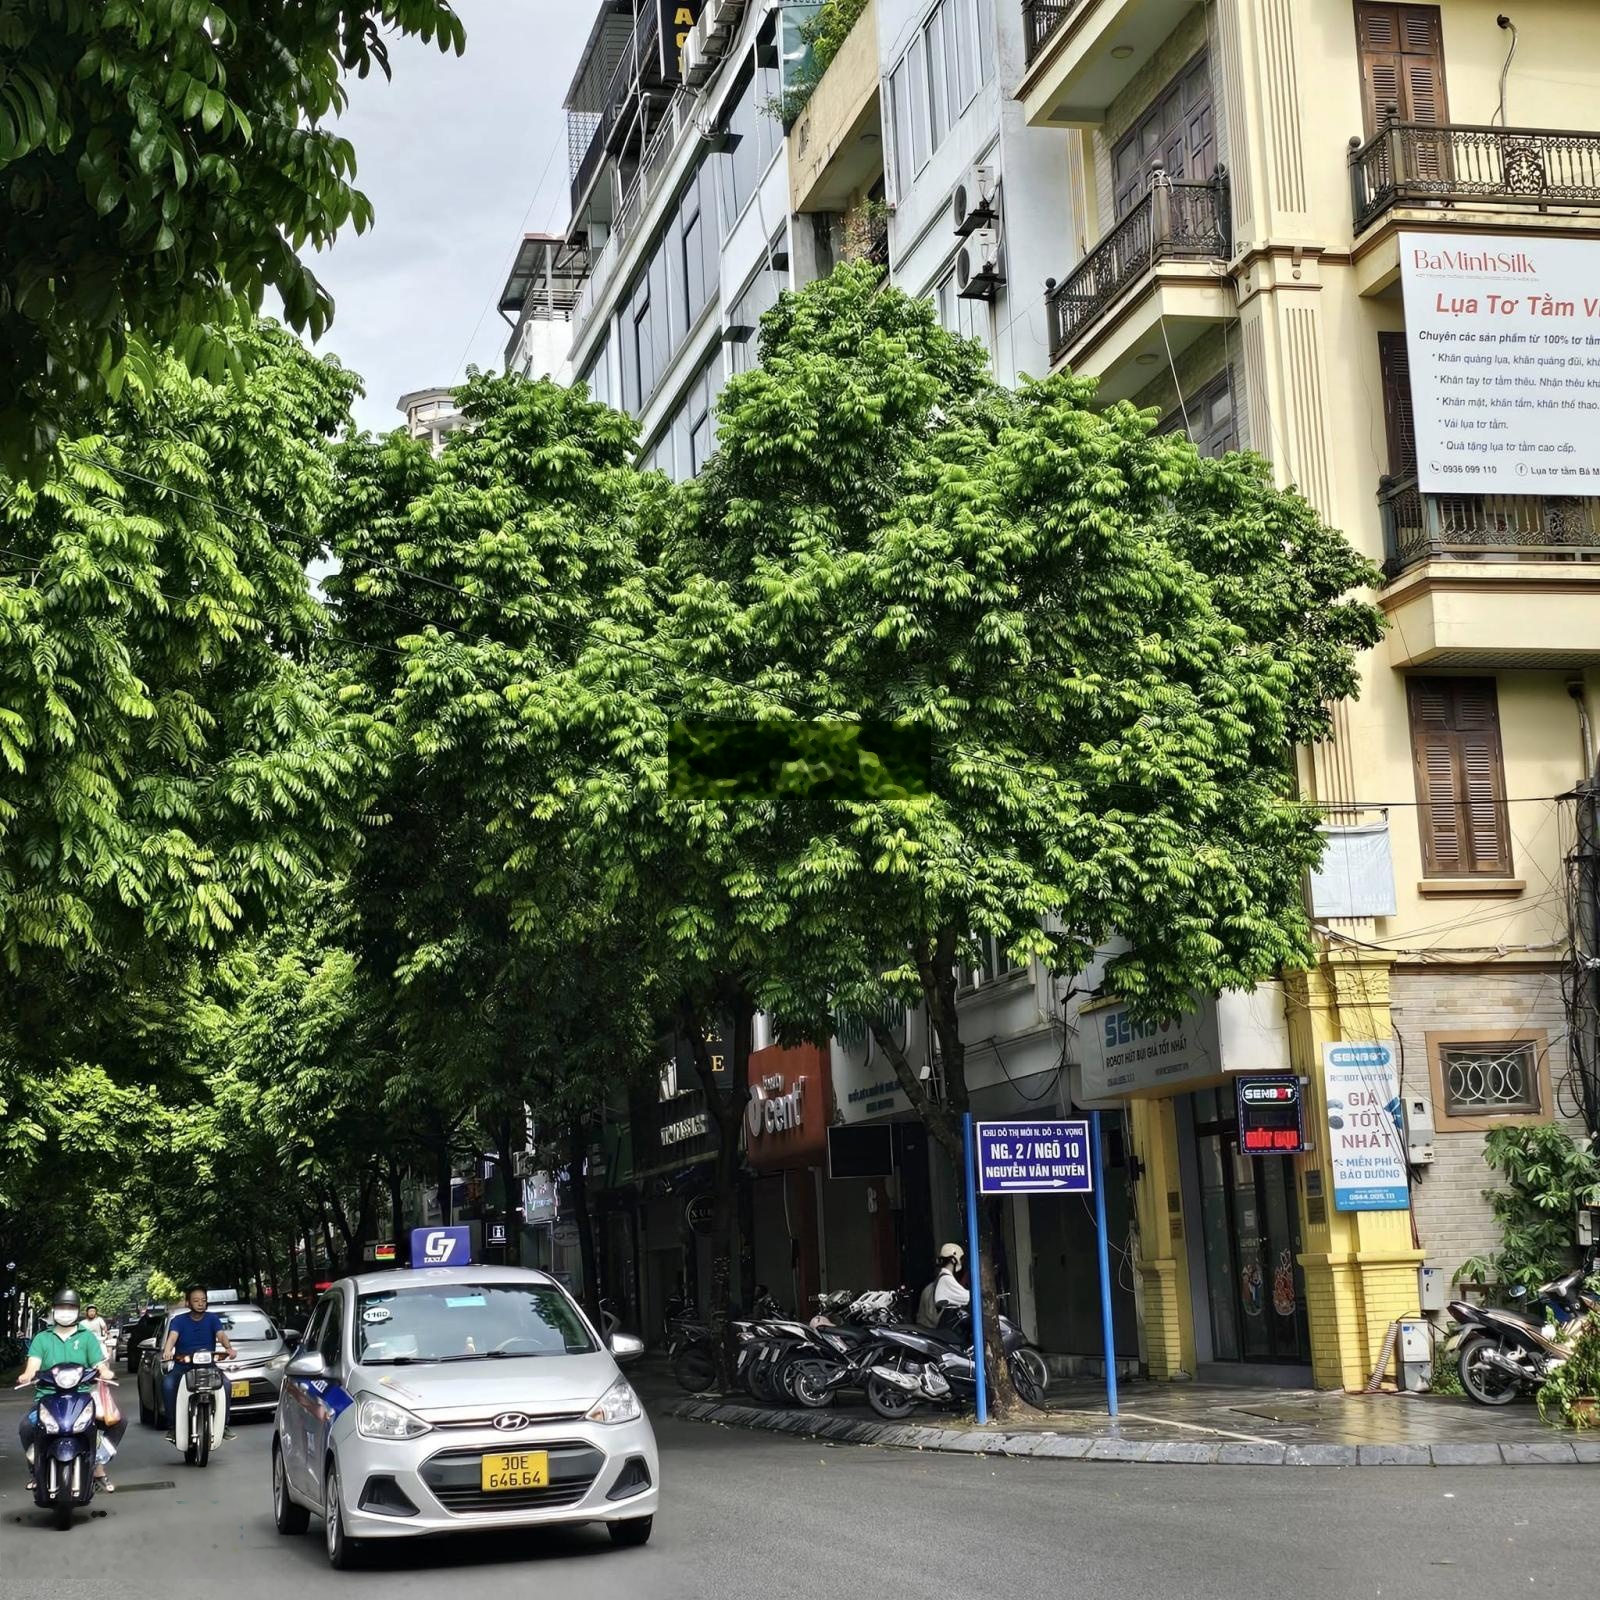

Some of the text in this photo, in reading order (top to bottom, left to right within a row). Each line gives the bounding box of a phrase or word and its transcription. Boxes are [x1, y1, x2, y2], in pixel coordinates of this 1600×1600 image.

[1414, 249, 1536, 273] BaMinhSilk
[1436, 293, 1478, 317] Lụa
[1487, 295, 1519, 315] Tơ
[1527, 293, 1574, 316] Tằm
[1419, 331, 1456, 343] Chuyên
[1459, 332, 1476, 342] các
[1479, 332, 1496, 342] sản
[1499, 332, 1526, 344] phẩm
[1529, 333, 1541, 343] từ
[1544, 335, 1568, 344] 100%
[1571, 336, 1582, 345] tơ
[1438, 353, 1461, 363] Khăn
[1440, 375, 1463, 385] Khăn
[1466, 376, 1480, 387] tay
[1483, 377, 1493, 385] tơ
[1442, 397, 1465, 407] Khăn
[1491, 398, 1513, 408] khăn
[1537, 398, 1559, 408] khăn
[1444, 418, 1458, 428] Vải
[1460, 418, 1474, 429] lụa
[1477, 420, 1488, 429] tơ
[1446, 440, 1465, 450] Quà
[1468, 441, 1488, 452] tặng
[1490, 441, 1504, 452] lụa
[1506, 442, 1516, 451] tơ
[1538, 443, 1555, 452] cao
[1465, 465, 1480, 473] 099
[1483, 465, 1497, 474] 110
[1106, 1053, 1124, 1068] ROBOT
[1125, 1050, 1136, 1065] HÚT
[1245, 1088, 1293, 1100] SENBOT
[1348, 1089, 1379, 1107] GIÁ
[1349, 1108, 1380, 1127] TỐT
[982, 1129, 996, 1137] KHU
[1065, 1128, 1083, 1138] VỌNG
[1342, 1129, 1391, 1149] NHẤT
[991, 1139, 1079, 1159] NG. 2 / NGÕ 10
[985, 1161, 1085, 1178] NGUYỄN VĂN HUYÊN
[425, 1231, 456, 1262] G7
[501, 1455, 528, 1470] 30E
[490, 1471, 541, 1488] 646.64
